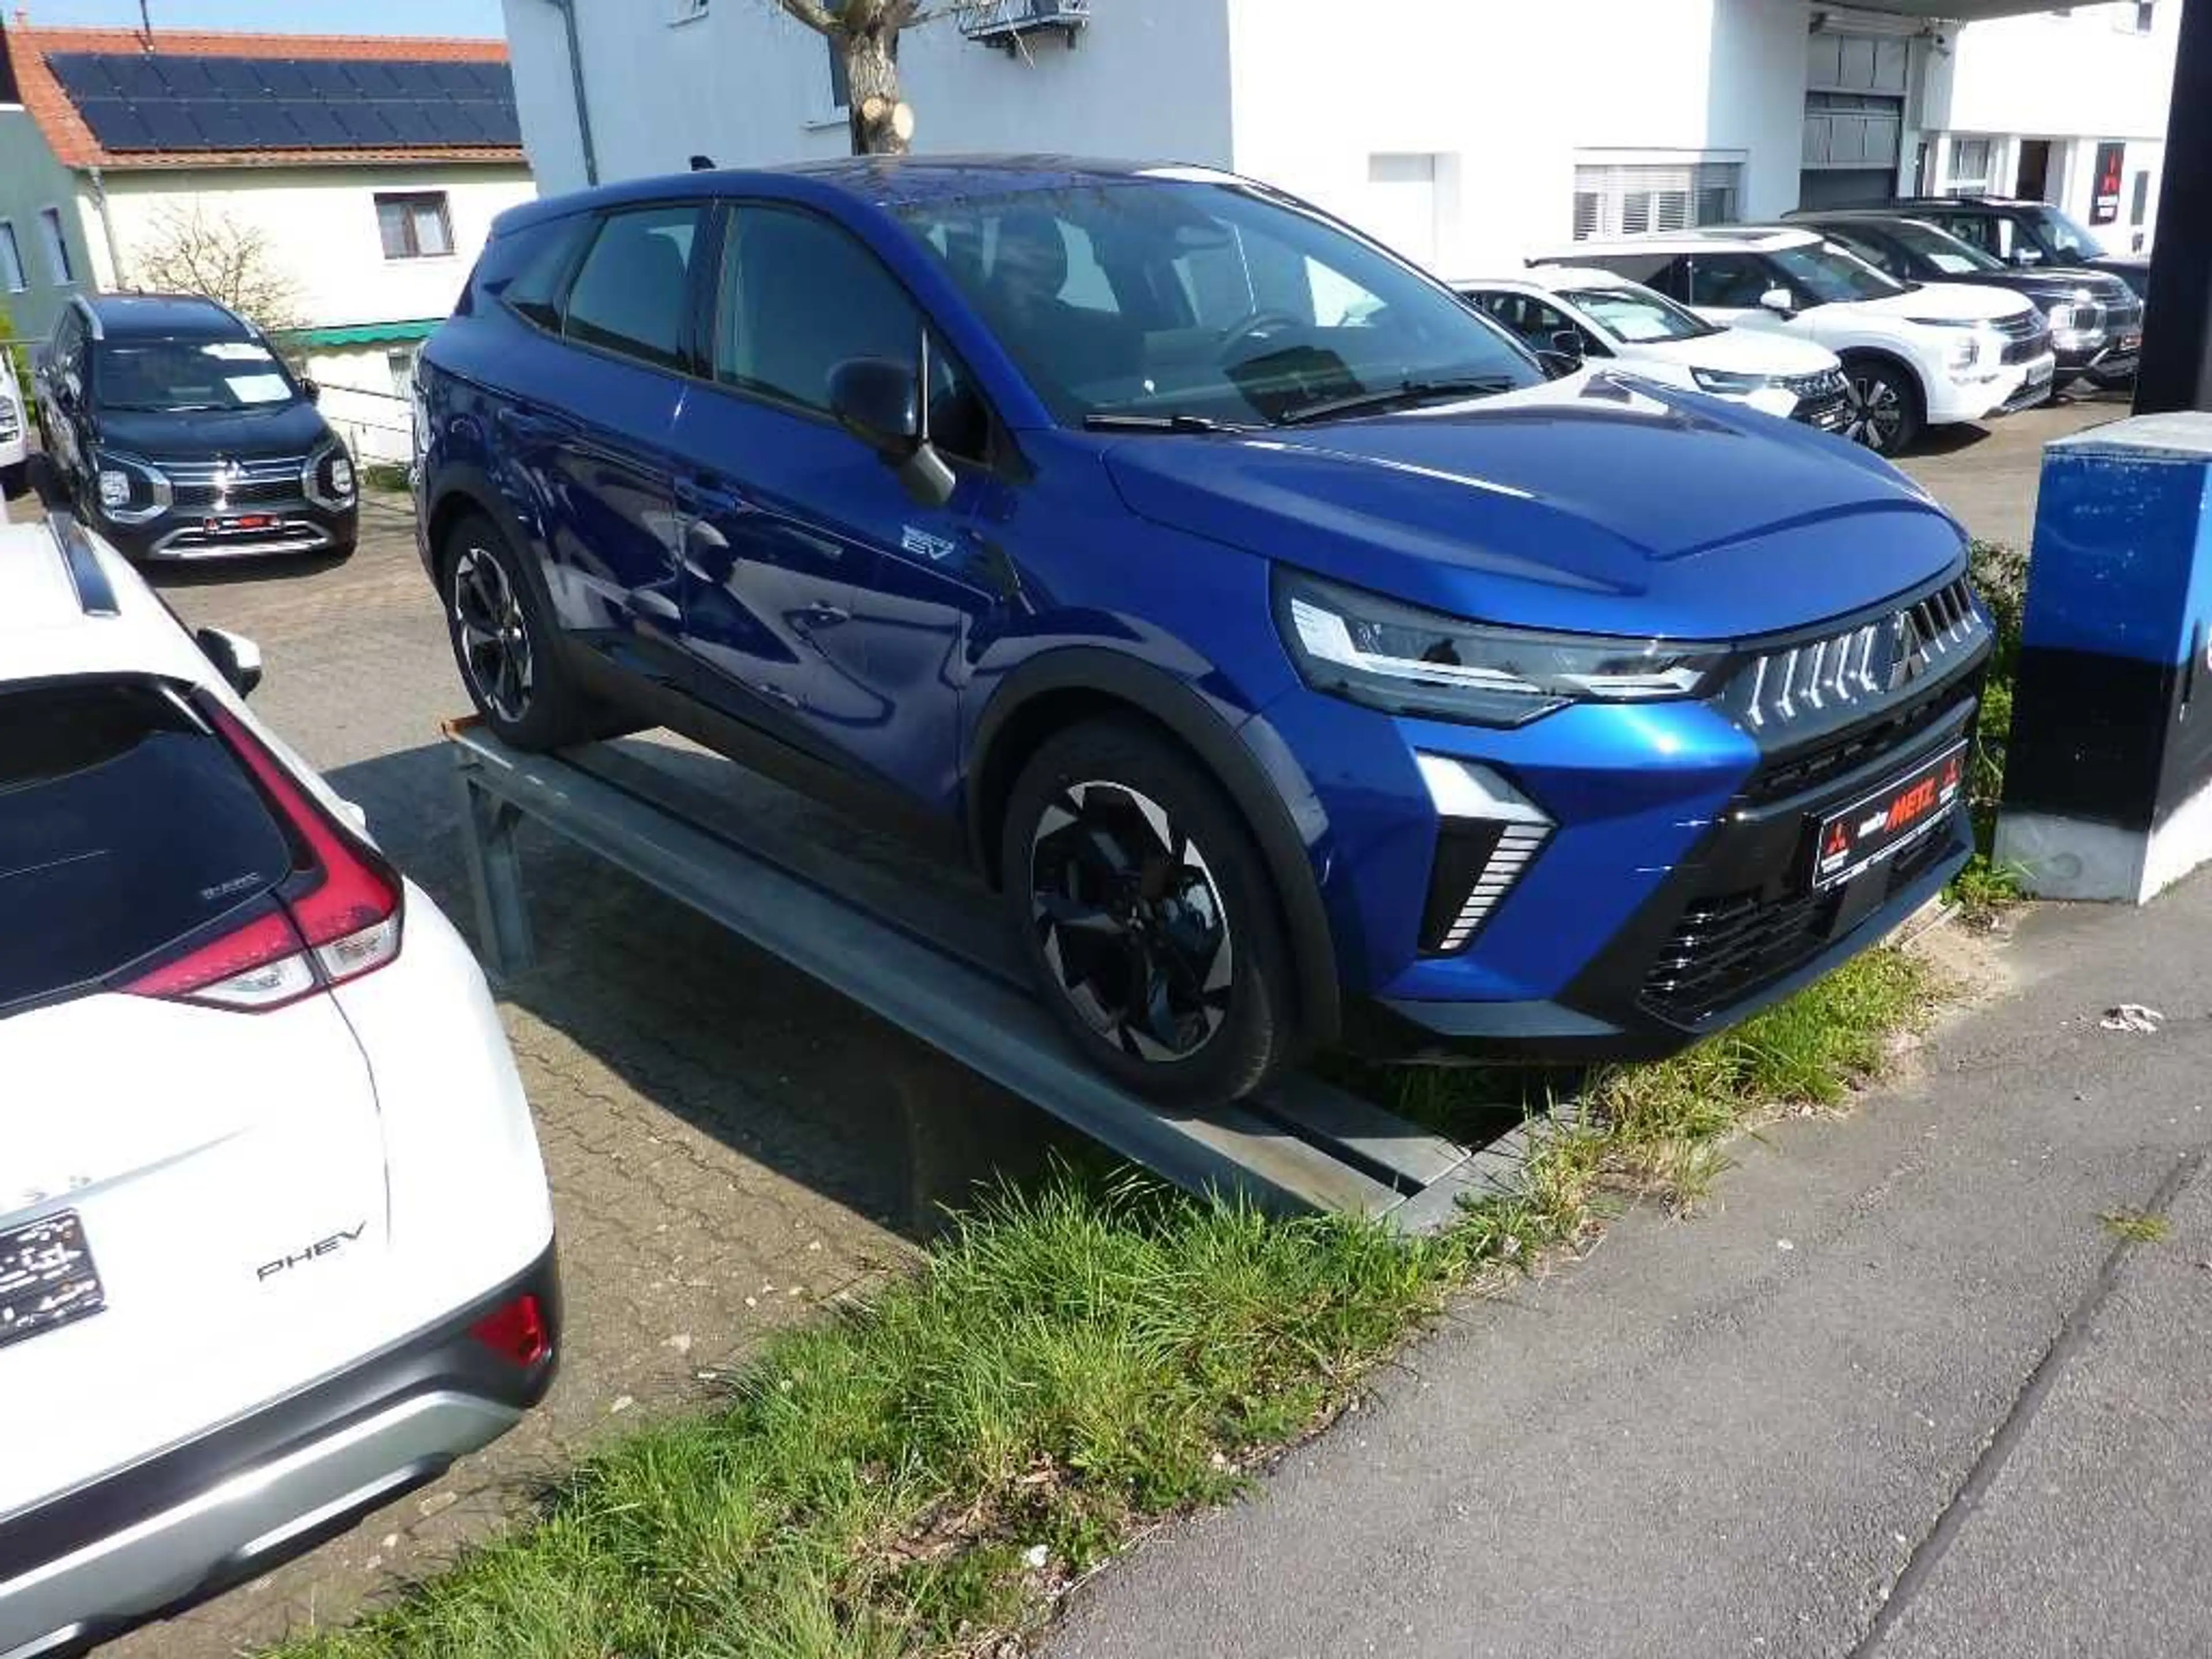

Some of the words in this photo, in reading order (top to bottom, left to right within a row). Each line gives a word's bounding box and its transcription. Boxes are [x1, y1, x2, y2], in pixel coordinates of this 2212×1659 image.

[902, 525, 954, 560] EV
[1883, 777, 1936, 832] METZ
[257, 1219, 366, 1282] PHEV
